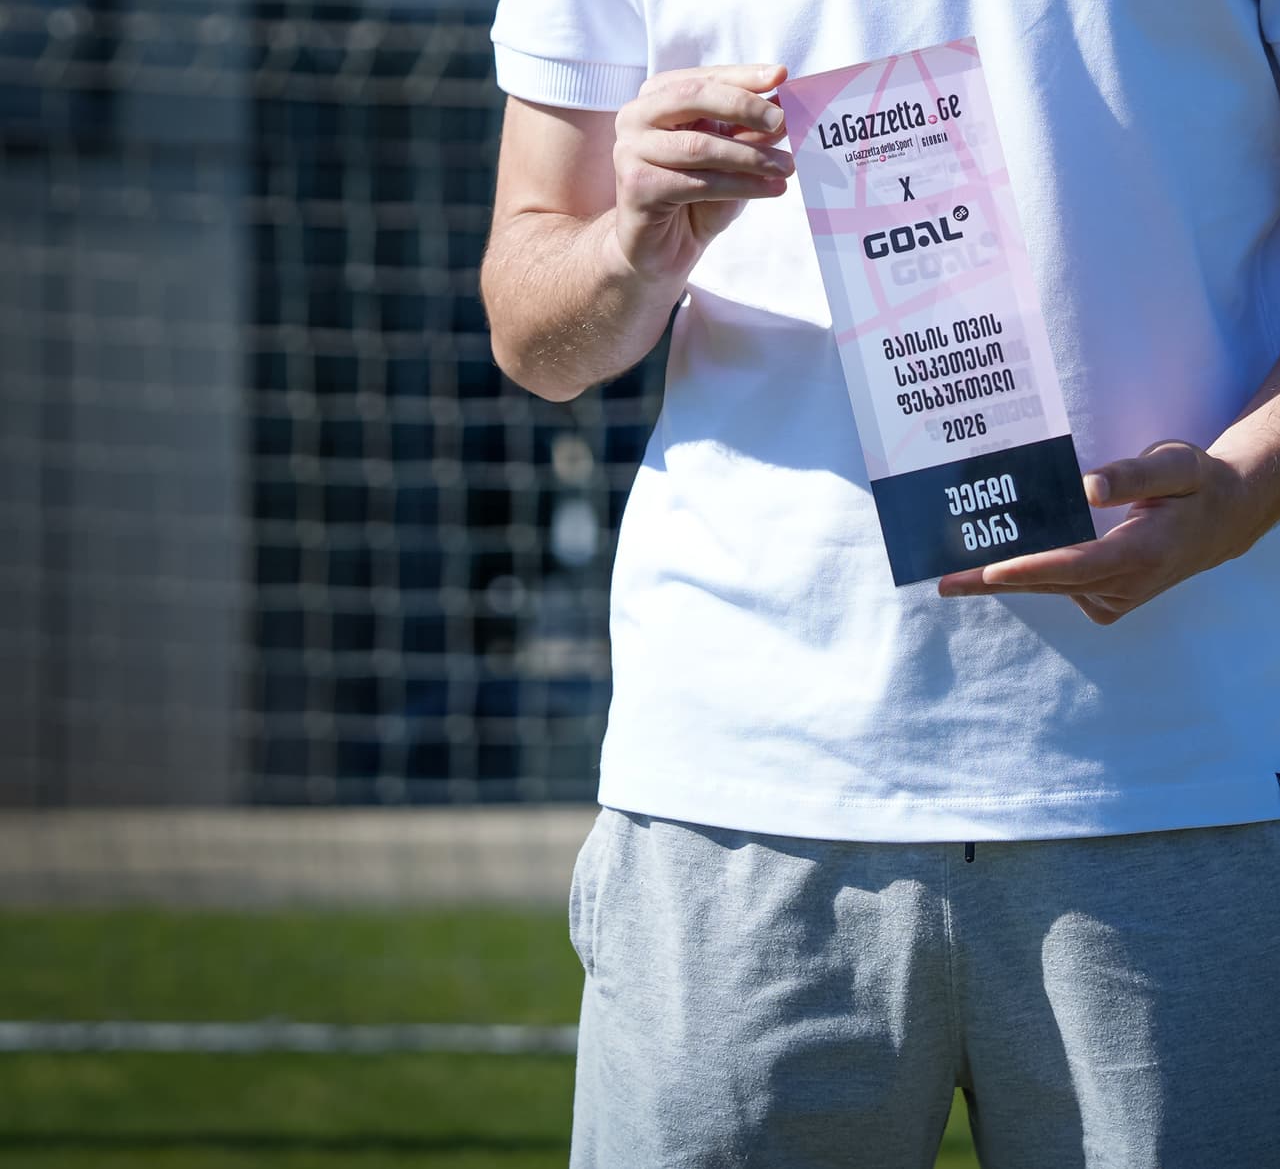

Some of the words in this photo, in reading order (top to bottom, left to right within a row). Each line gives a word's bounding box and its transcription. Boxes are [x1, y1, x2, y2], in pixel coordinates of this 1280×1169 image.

[863, 216, 964, 260] GOAL
[882, 326, 949, 360] მაისის
[953, 313, 1003, 344] თვის
[894, 342, 1005, 387] საუკეთესო
[896, 369, 1016, 415] ფეხბურთელი
[942, 413, 988, 444] 2026
[944, 473, 1018, 516] უერდი
[961, 512, 1019, 551] მარა
